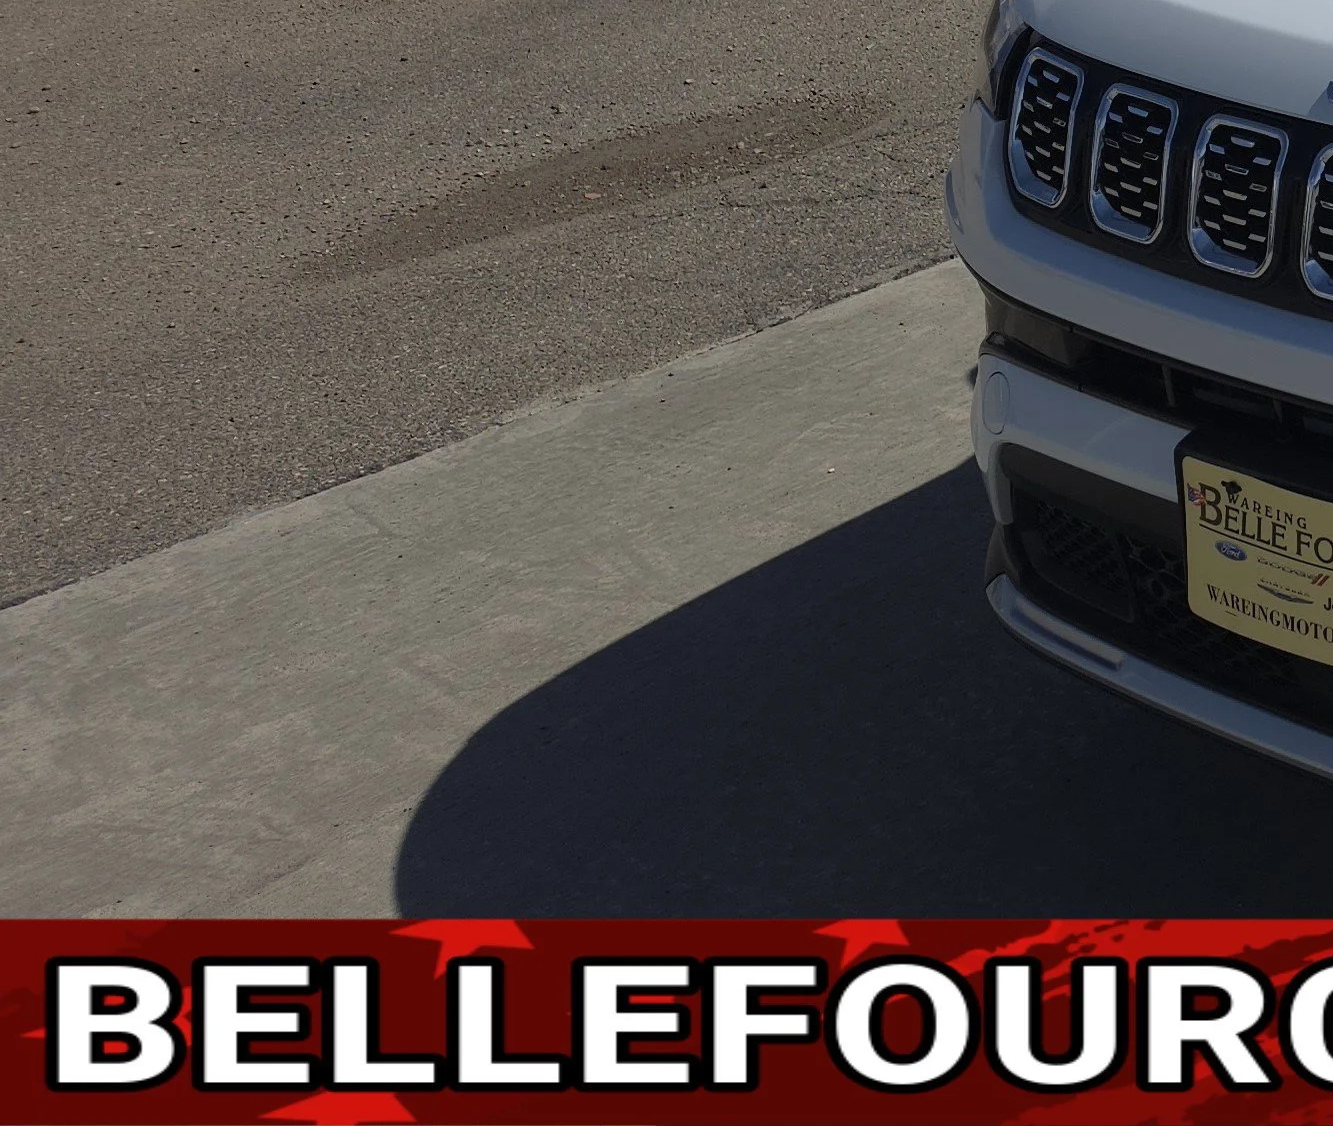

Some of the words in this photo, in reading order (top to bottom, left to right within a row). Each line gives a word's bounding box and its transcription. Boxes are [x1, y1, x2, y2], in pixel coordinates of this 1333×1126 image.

[1198, 481, 1288, 552] BELLE
[1227, 492, 1307, 530] WAREING
[1221, 544, 1241, 558] Ford
